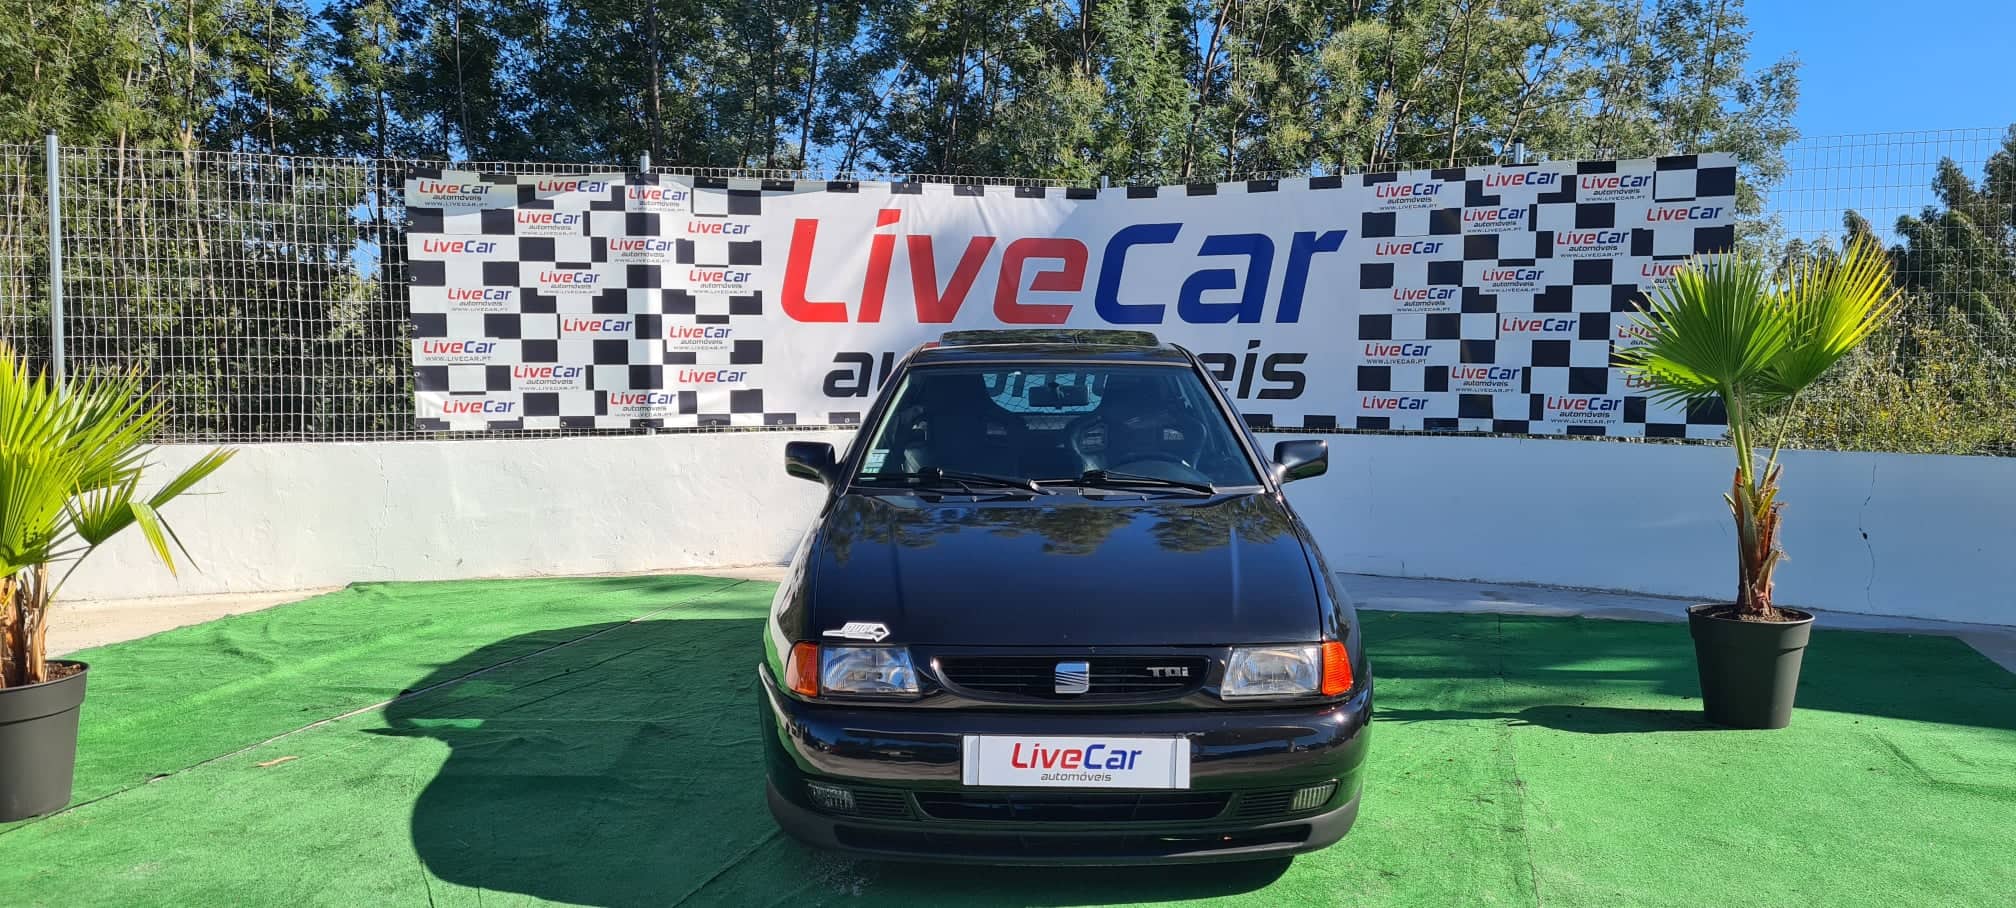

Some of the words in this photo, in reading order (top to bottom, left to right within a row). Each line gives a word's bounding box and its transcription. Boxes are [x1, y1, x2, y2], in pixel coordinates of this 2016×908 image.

[538, 180, 608, 192] LiveCar
[1485, 171, 1559, 187] LiveCar
[1582, 175, 1652, 189] LiveCar
[419, 181, 493, 194] LiveCar
[628, 187, 689, 201] LiveCar
[1376, 183, 1444, 198] LiveCar
[517, 211, 581, 224] LiveCar
[1463, 207, 1527, 222] LiveCar
[1646, 206, 1723, 221] LiveCar
[687, 221, 751, 235] LiveCar
[610, 238, 674, 251] LiveCar
[1557, 230, 1629, 245] LiveCar
[423, 239, 496, 253] LiveCar
[1375, 240, 1444, 256] LiveCar
[781, 209, 1348, 324] LiveCar
[540, 271, 600, 283] LiveCar
[689, 269, 751, 283] LiveCar
[1482, 269, 1544, 281] LiveCar
[447, 287, 512, 301] LiveCar
[1393, 287, 1456, 300] LiveCar
[563, 318, 633, 332] LiveCar
[1502, 316, 1577, 332] LiveCar
[669, 325, 732, 339] LiveCar
[423, 339, 496, 354] LiveCar
[1364, 343, 1432, 357] LiveCar
[513, 364, 583, 378] LiveCar
[678, 369, 747, 383] LiveCar
[1452, 365, 1520, 380] LiveCar
[610, 392, 676, 405] LiveCar
[1362, 395, 1428, 410] LiveCar
[1547, 396, 1622, 411] LiveCar
[443, 400, 516, 413] LiveCar
[1011, 742, 1143, 770] LiveCar
[1040, 772, 1112, 782] automóveis
